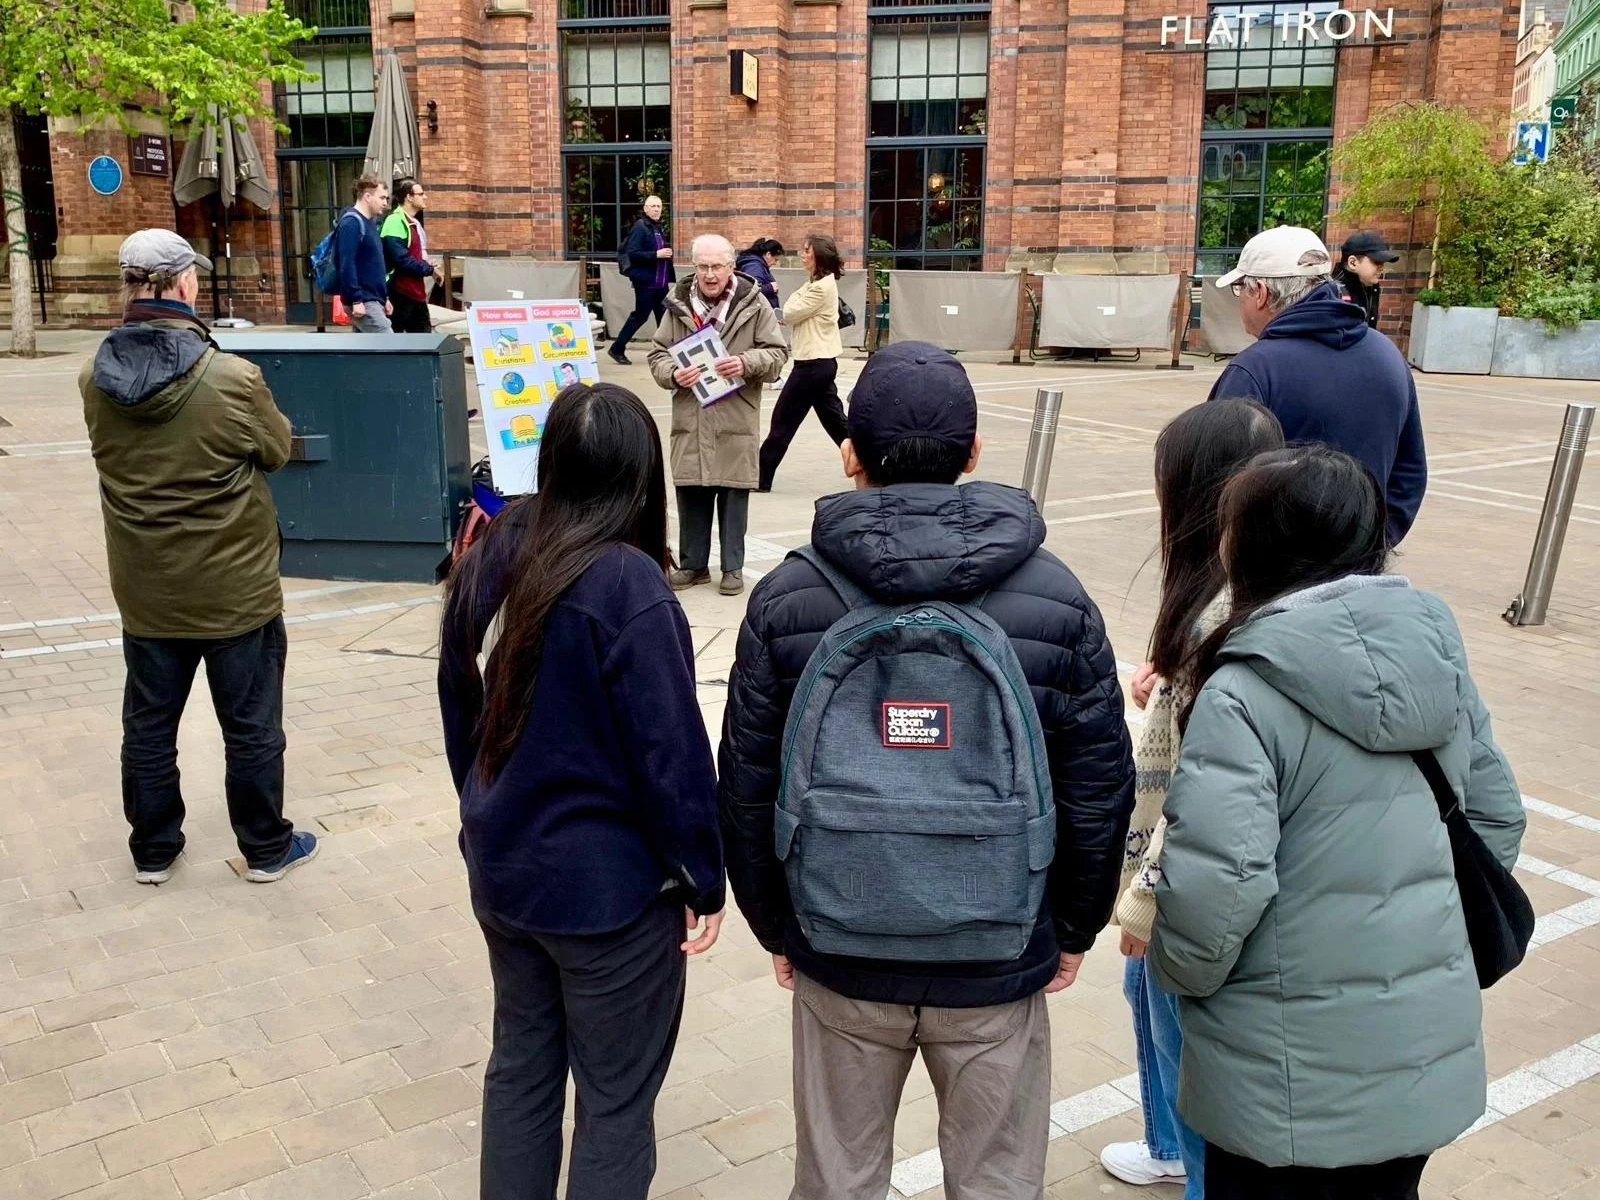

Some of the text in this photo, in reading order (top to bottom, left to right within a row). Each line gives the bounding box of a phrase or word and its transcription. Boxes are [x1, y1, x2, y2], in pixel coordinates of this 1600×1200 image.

[1160, 8, 1394, 45] FLAT IRON
[482, 307, 579, 320] How does God speak?
[542, 350, 588, 359] Circumstances
[494, 357, 526, 365] Christians
[504, 397, 531, 405] Creation
[888, 706, 937, 720] Superdry
[888, 717, 923, 727] Japan
